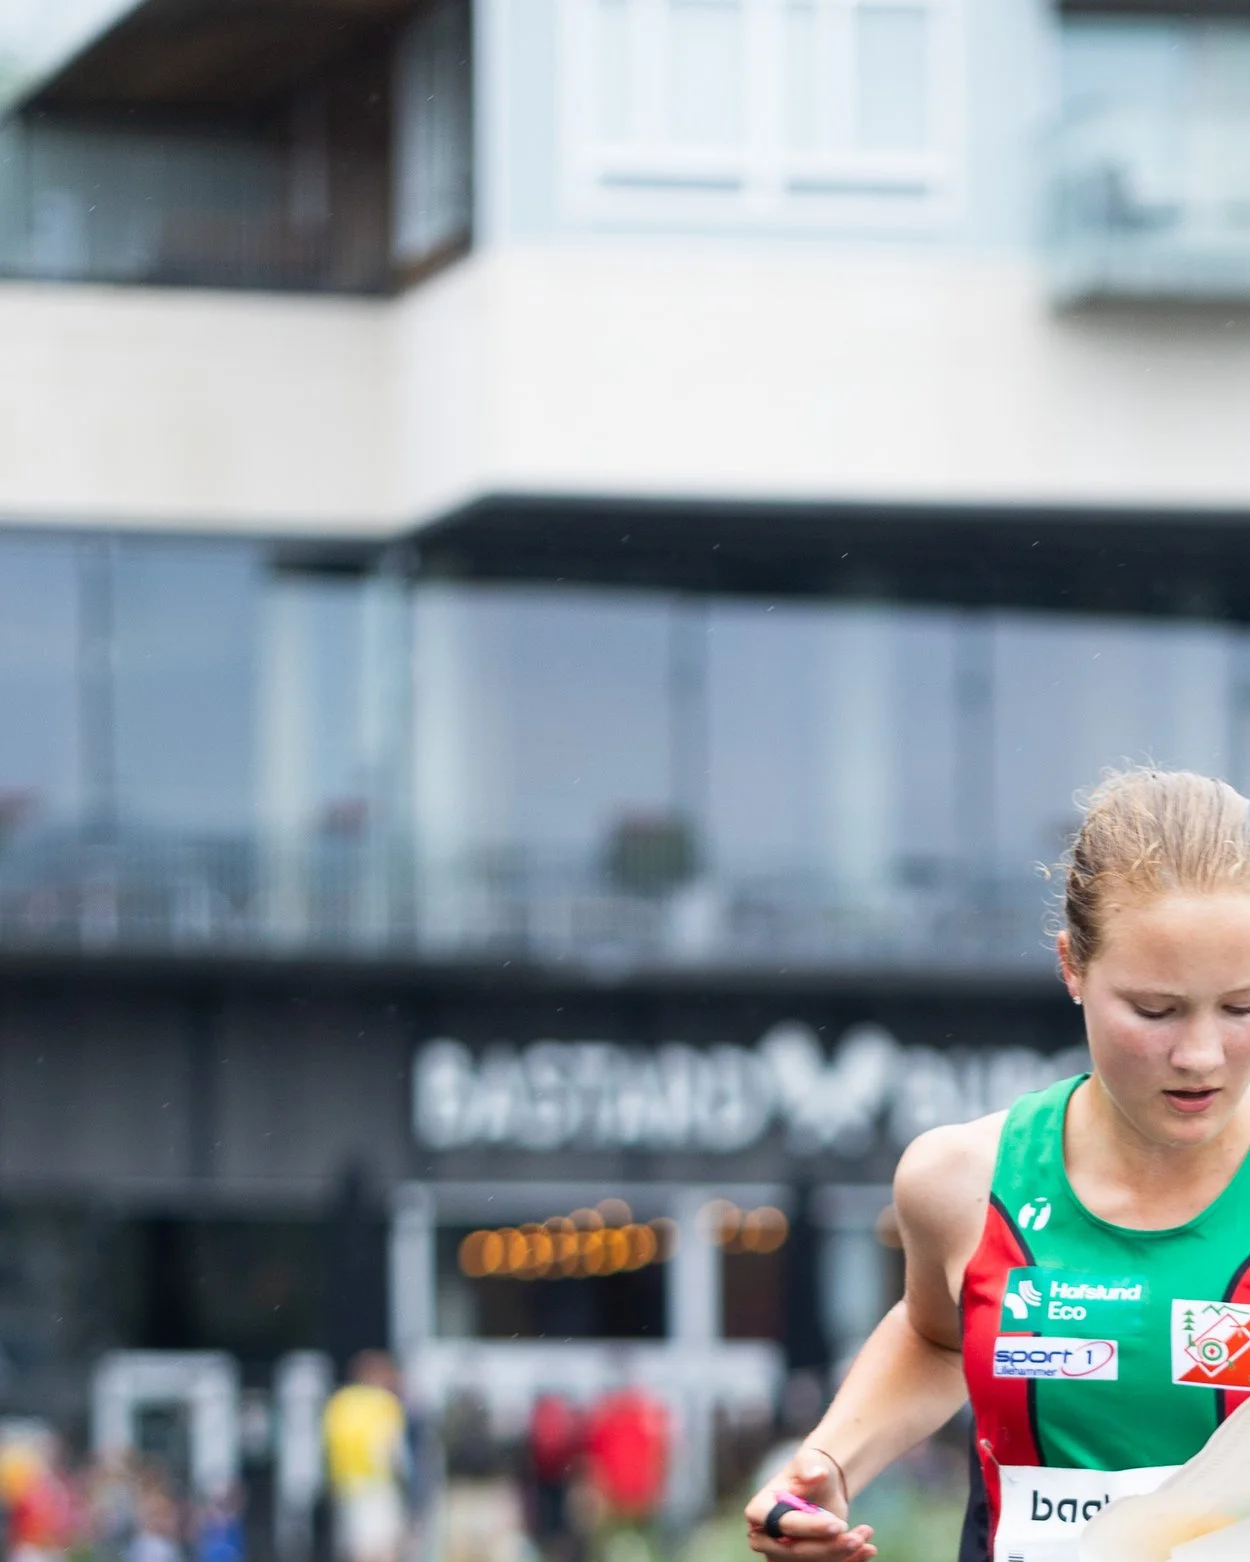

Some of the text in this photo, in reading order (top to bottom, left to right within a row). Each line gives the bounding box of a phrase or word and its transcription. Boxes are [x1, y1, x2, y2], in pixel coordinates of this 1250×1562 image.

[1050, 1281, 1142, 1300] Hafslund
[1047, 1301, 1087, 1320] Eco
[995, 1349, 1093, 1367] sport 1
